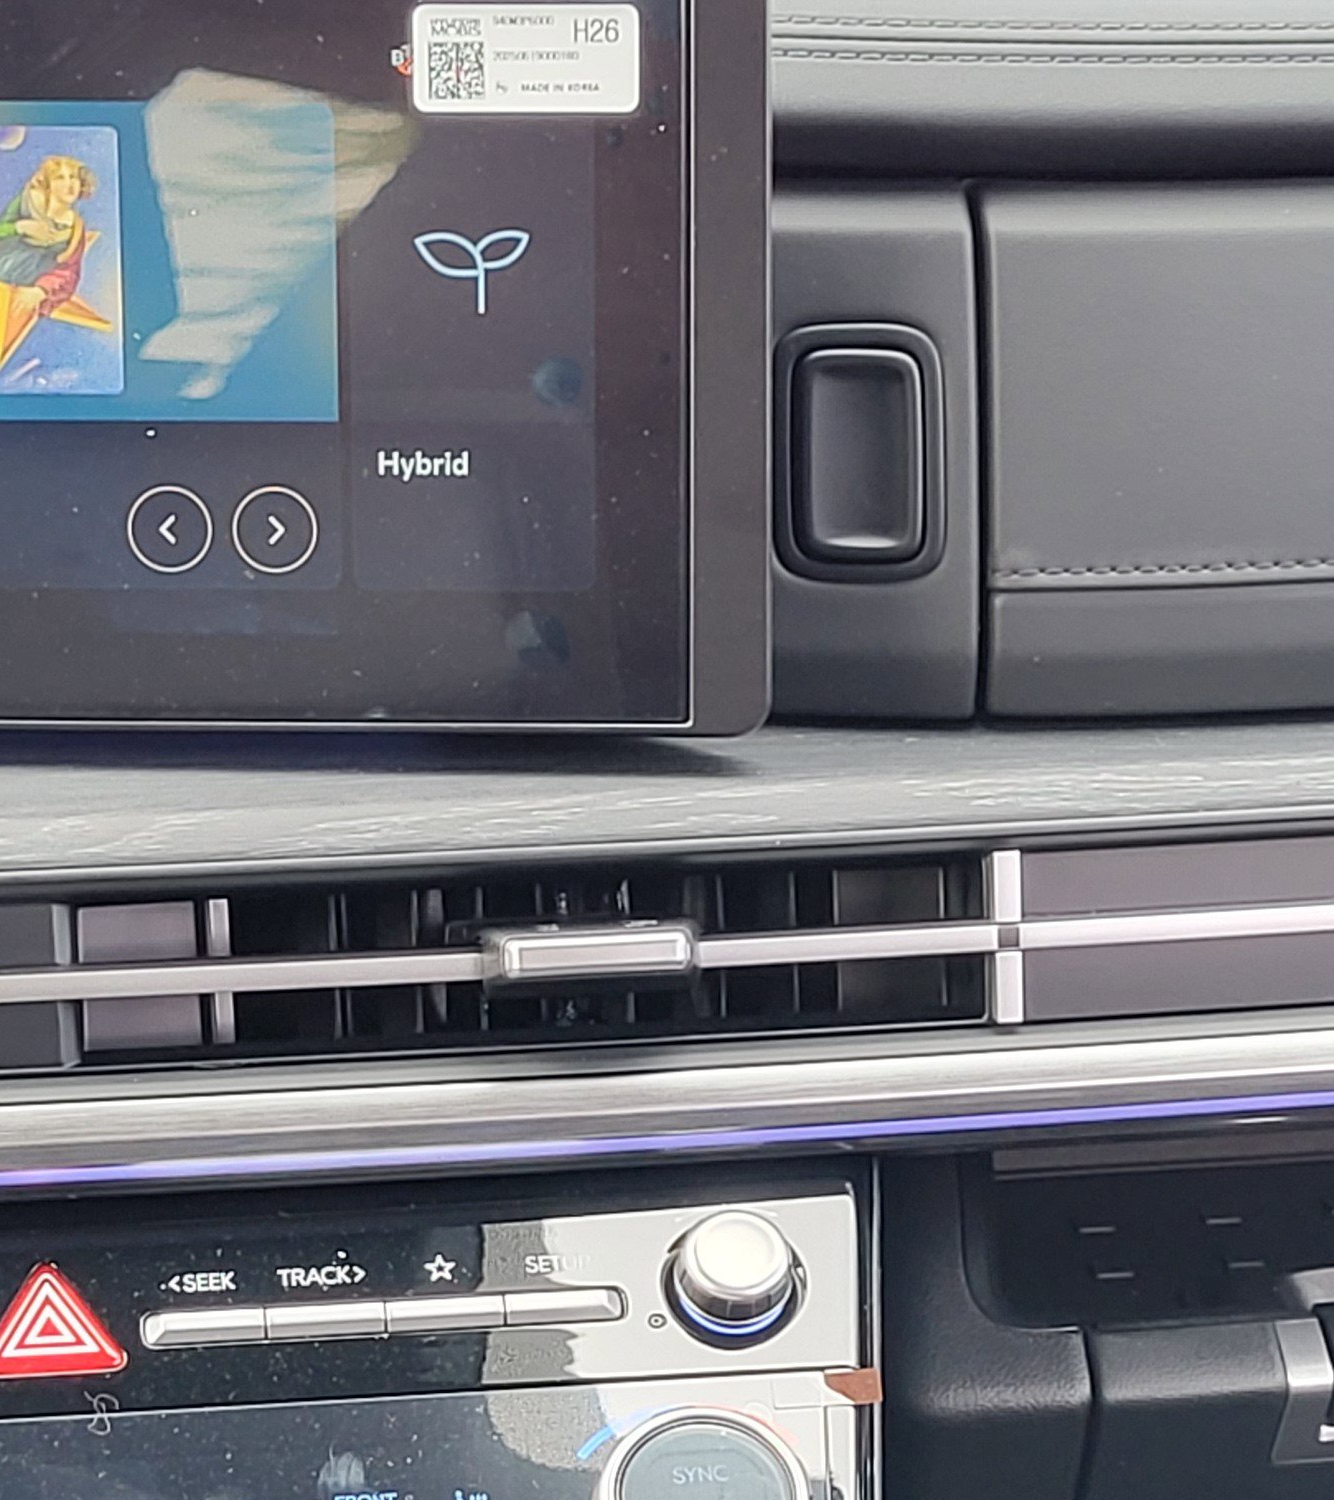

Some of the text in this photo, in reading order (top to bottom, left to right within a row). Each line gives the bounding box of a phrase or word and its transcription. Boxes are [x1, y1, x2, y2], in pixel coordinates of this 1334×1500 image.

[573, 18, 620, 44] H26
[377, 449, 470, 483] Hybrid
[672, 1465, 730, 1485] SYNC
